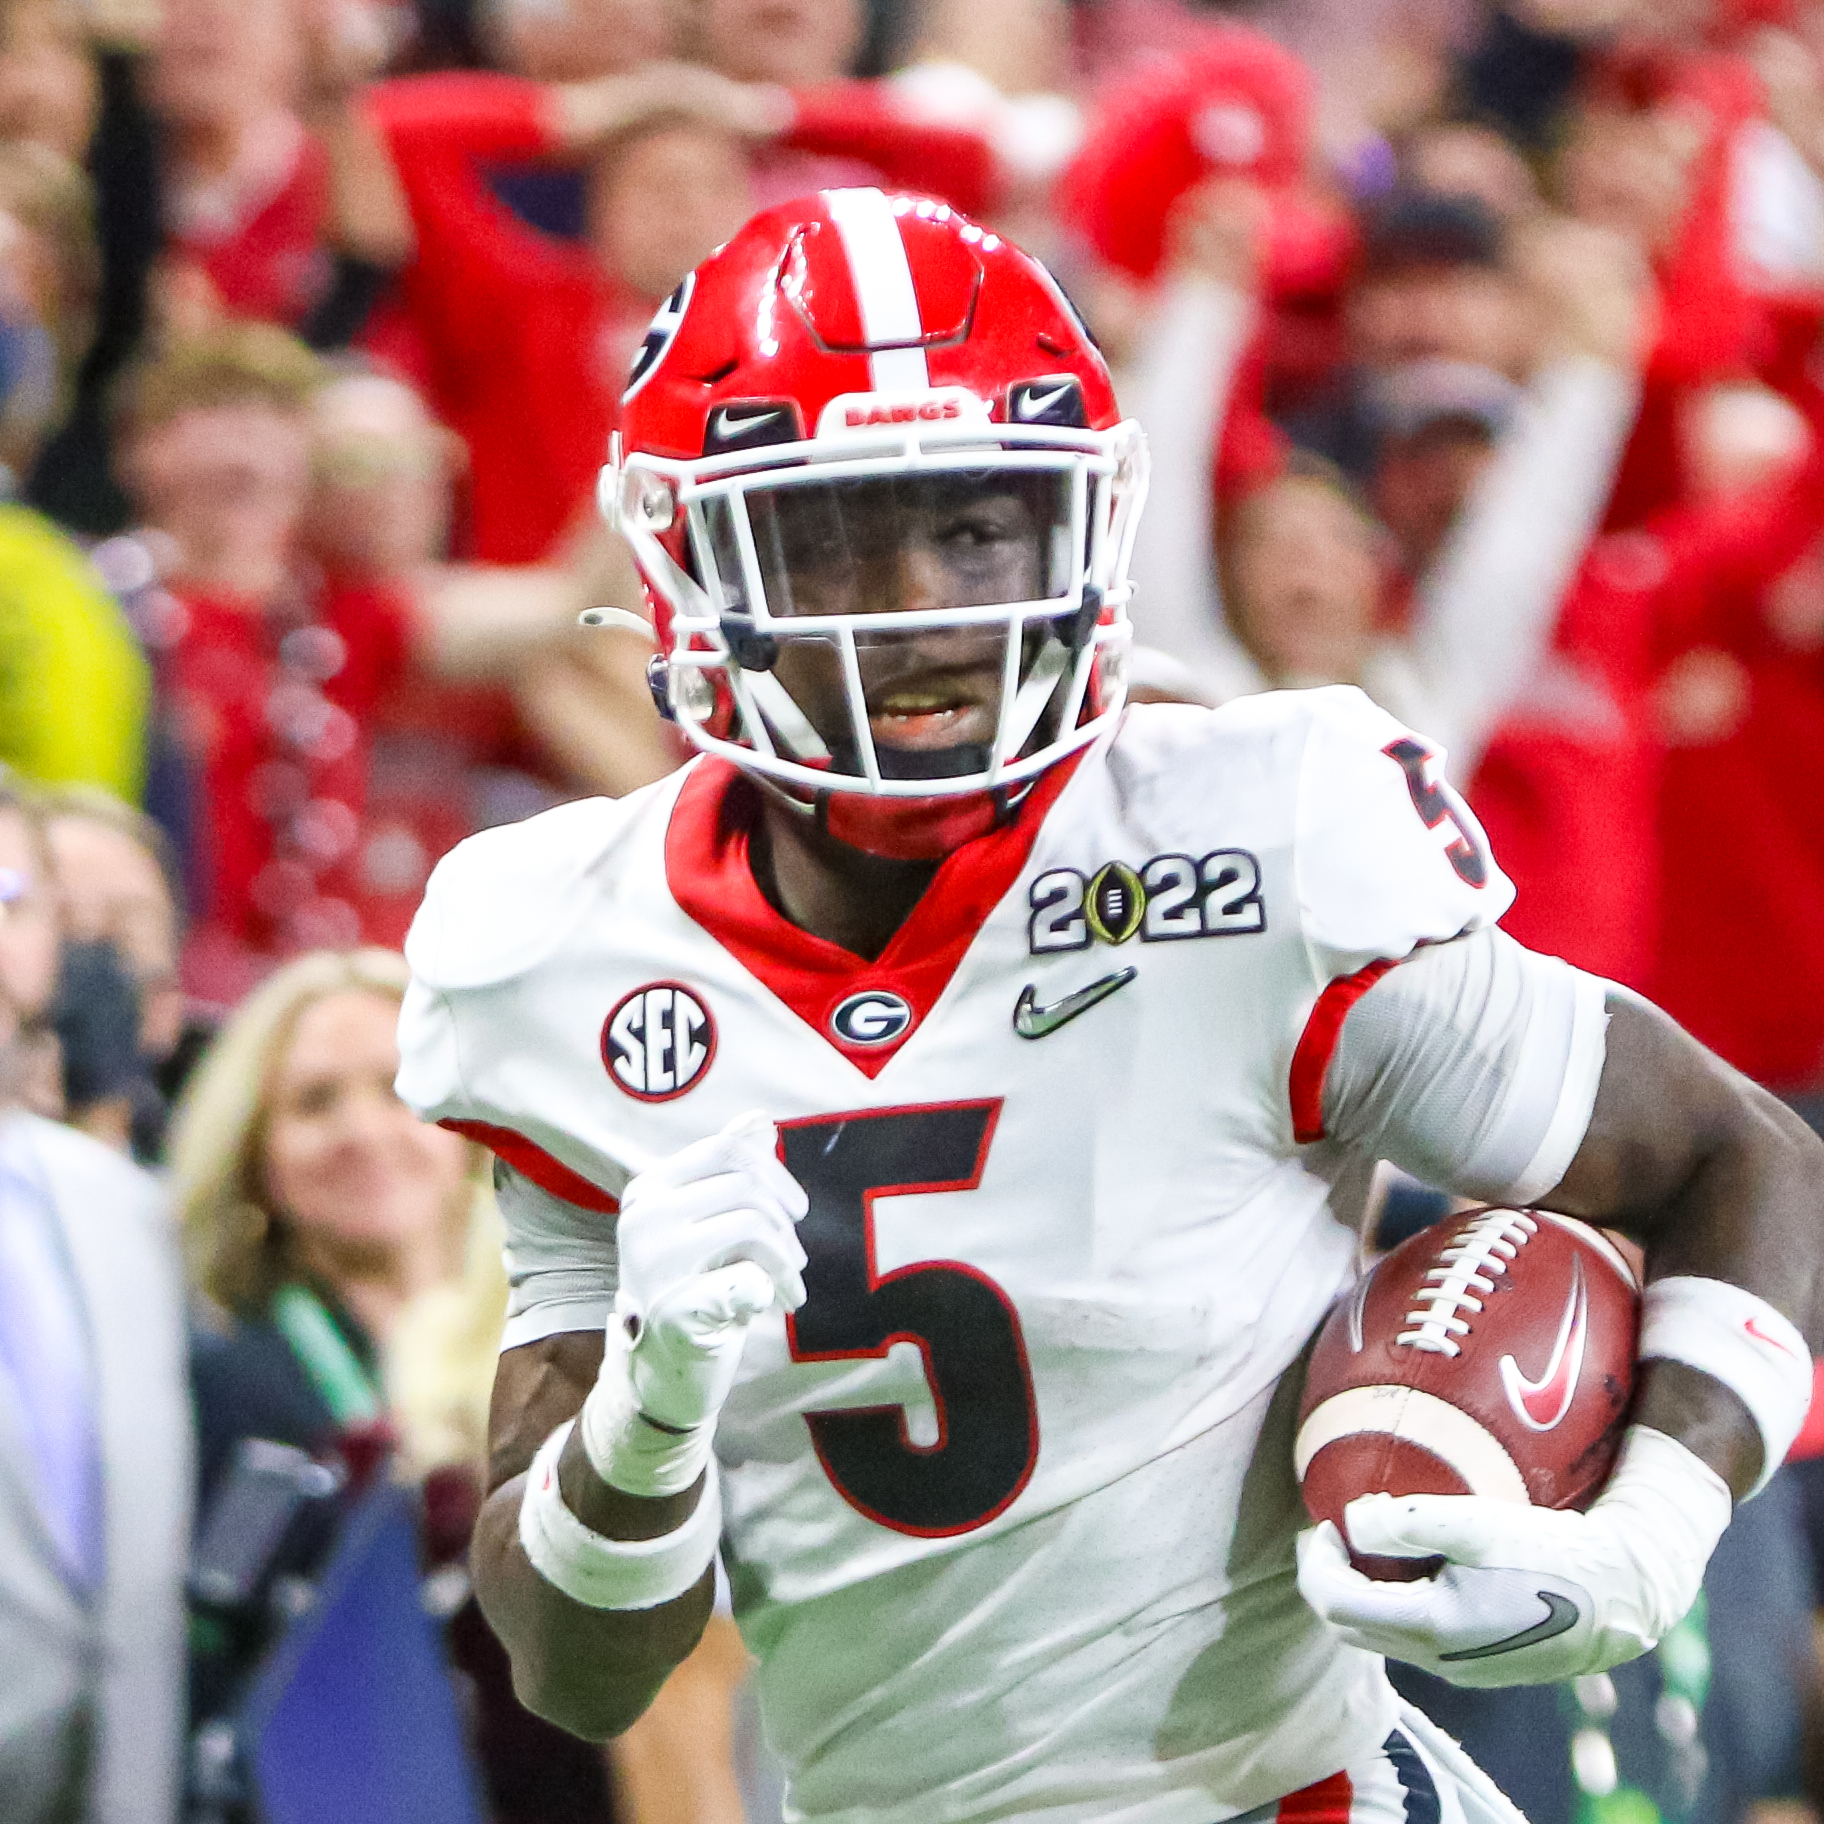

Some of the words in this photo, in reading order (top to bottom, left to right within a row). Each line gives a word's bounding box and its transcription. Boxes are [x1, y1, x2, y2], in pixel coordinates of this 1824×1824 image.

[1380, 736, 1488, 889] 5
[1029, 847, 1267, 955] 2022
[609, 988, 708, 1093] SEC
[774, 1096, 1040, 1538] 5
